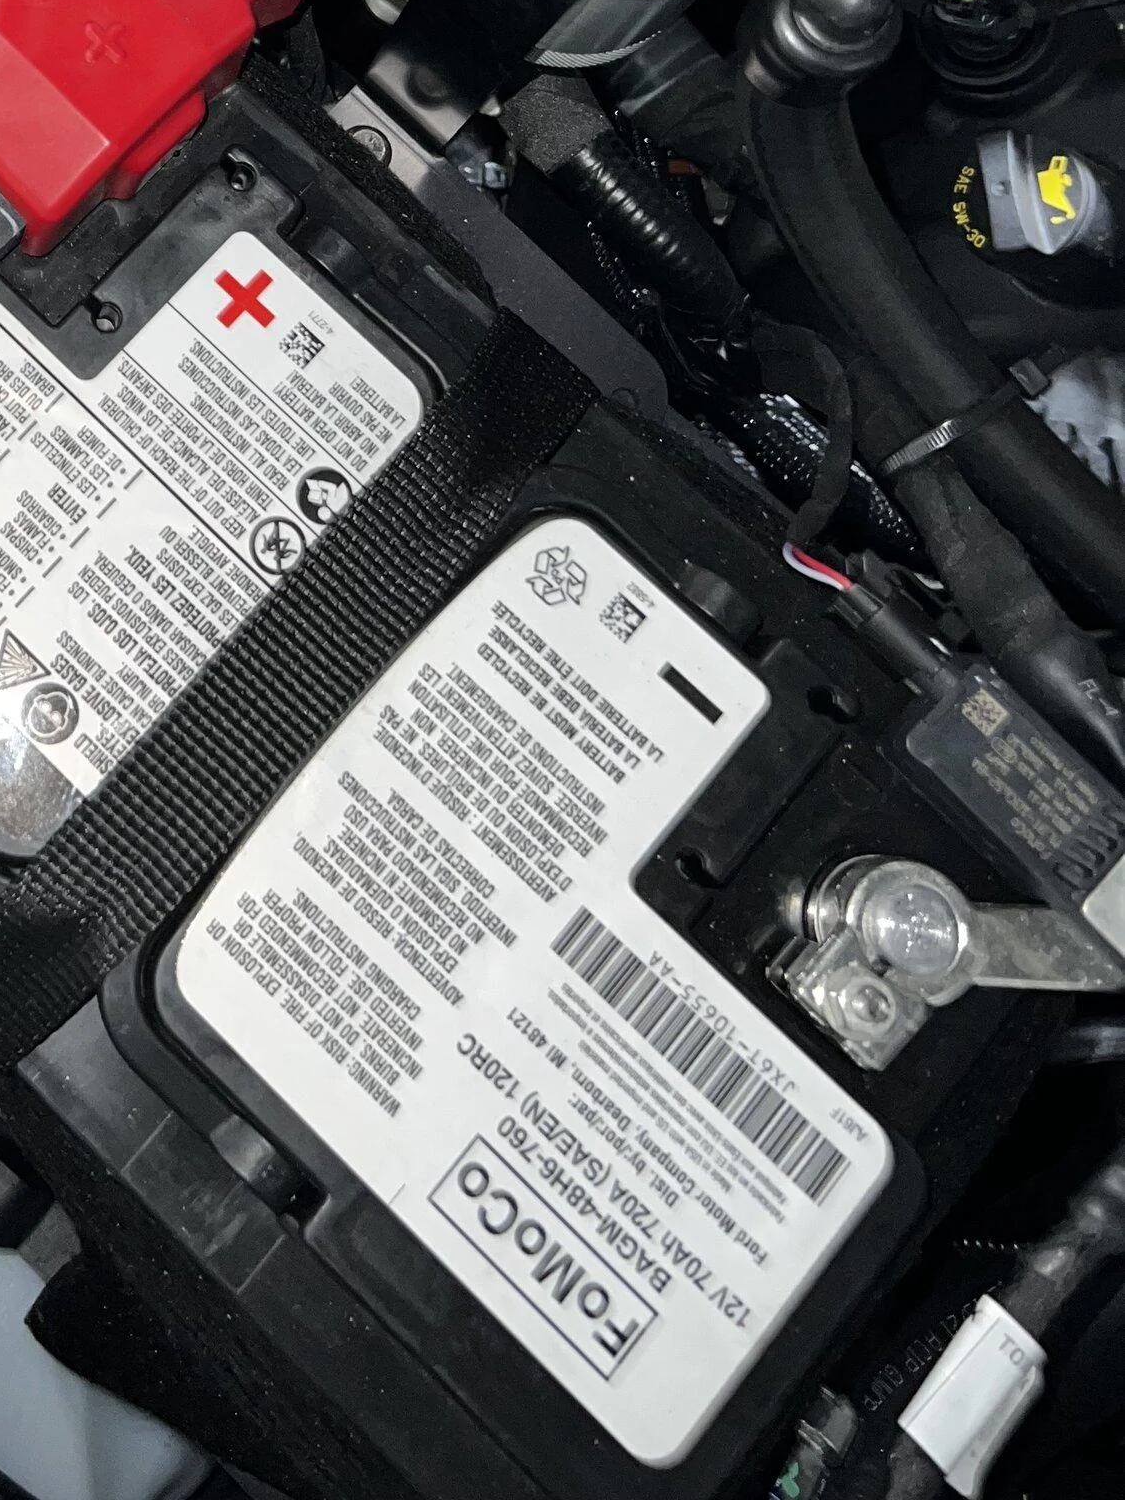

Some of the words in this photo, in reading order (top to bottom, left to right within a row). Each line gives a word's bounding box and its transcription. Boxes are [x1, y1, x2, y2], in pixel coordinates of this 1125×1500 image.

[953, 164, 976, 195] SAE
[952, 200, 987, 250] 5W-30
[117, 356, 157, 399] ENFANTS.
[189, 337, 250, 400] INSTRUCTIONS.
[151, 392, 173, 414] DES
[177, 353, 243, 421] INSTRUCCIONES.
[244, 393, 266, 414] LES
[97, 392, 141, 438] CHILDREN.
[141, 409, 163, 431] LOS
[189, 391, 251, 454] INSTRUCTIONS.
[238, 414, 260, 436] LAS
[260, 408, 296, 444] TOUTES
[135, 433, 153, 449] OF
[157, 424, 175, 443] DE
[198, 435, 215, 454] LA
[254, 429, 286, 462] TODAS
[290, 436, 316, 461] LIRE
[147, 443, 180, 476] REACH
[168, 435, 211, 476] ALCANCE
[208, 447, 226, 465] DE
[247, 447, 268, 469] ALL
[282, 454, 303, 476] LEA
[173, 468, 195, 492] THE
[206, 469, 226, 492] DEL
[221, 459, 249, 487] HORS
[262, 463, 290, 491] READ
[190, 486, 208, 502] OF
[201, 496, 225, 519] OUT
[244, 480, 273, 512] TENIR
[16, 489, 62, 536] CIGARROS
[220, 515, 246, 540] KEEP
[0, 521, 39, 561] CHISPAS
[12, 510, 50, 549] FLAMAS
[477, 642, 533, 697] RECYCLED
[487, 624, 553, 688] RECICLARSE
[529, 691, 548, 711] BE
[549, 682, 581, 714] DEBE
[569, 674, 599, 703] DOIT
[543, 707, 578, 740] MUST
[595, 697, 649, 748] BATTERIE
[574, 736, 625, 784] BATTERY
[623, 749, 641, 769] LA
[646, 742, 664, 762] LA
[337, 770, 417, 850] INSTRUCCIONES
[343, 804, 369, 831] USO
[365, 823, 396, 857] PARA
[419, 822, 439, 844] DE
[412, 844, 437, 869] LAS
[434, 837, 495, 899] CORRECTAS
[337, 881, 358, 902] DE
[382, 869, 399, 888] NI
[391, 850, 469, 929] RECOMENDADO
[433, 862, 461, 893] SIGA
[237, 894, 262, 920] FOR
[262, 888, 306, 936] PROPER
[353, 896, 394, 939] RIESGO
[390, 904, 403, 919] O
[394, 880, 453, 940] DESMONTE
[206, 918, 226, 940] OR
[233, 916, 253, 939] OR
[448, 933, 468, 955] NO
[464, 922, 485, 944] NO
[221, 934, 281, 997] EXPLOSION
[258, 914, 339, 996] RECOMMENDED
[300, 929, 348, 977] FOLLOW
[247, 932, 322, 1008] DISASSEMBLE
[332, 990, 360, 1018] NOT
[364, 962, 421, 1020] CHARGING
[303, 1019, 323, 1038] OF
[315, 1001, 343, 1029] NOT
[369, 996, 423, 1051] INVERTED
[506, 1006, 547, 1048] 48121
[318, 1031, 349, 1064] RISK
[339, 1023, 360, 1046] DO
[456, 1033, 519, 1099] 120RC
[545, 1044, 568, 1069] MI
[571, 1067, 632, 1132] Dearborn,
[520, 1091, 611, 1187] (SAE/EN)
[634, 1129, 696, 1195] Company,
[497, 1115, 672, 1294] BAGM-48H6-760
[608, 1178, 659, 1239] 720A
[694, 1190, 736, 1234] Motor
[457, 1162, 639, 1357] FoMoCo
[660, 1230, 712, 1292] 70Ah
[733, 1228, 768, 1266] Ford
[708, 1286, 750, 1328] 12V
